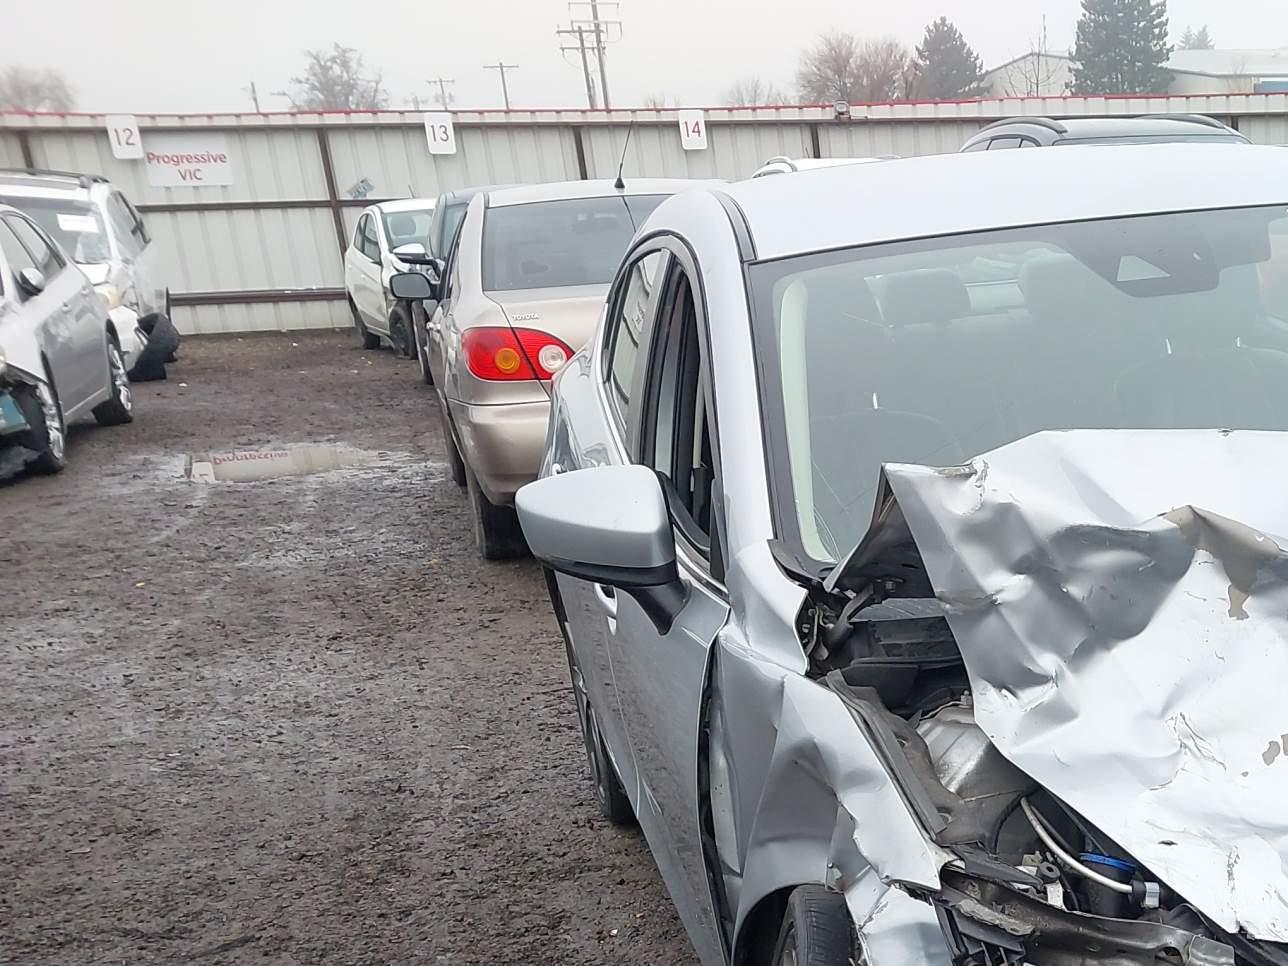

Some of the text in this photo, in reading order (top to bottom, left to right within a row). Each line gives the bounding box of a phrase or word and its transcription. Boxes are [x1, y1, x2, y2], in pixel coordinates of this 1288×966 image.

[114, 127, 136, 147] 12
[430, 124, 449, 143] 13
[682, 120, 702, 138] 14
[146, 150, 227, 167] Progressive
[177, 168, 203, 181] VIC
